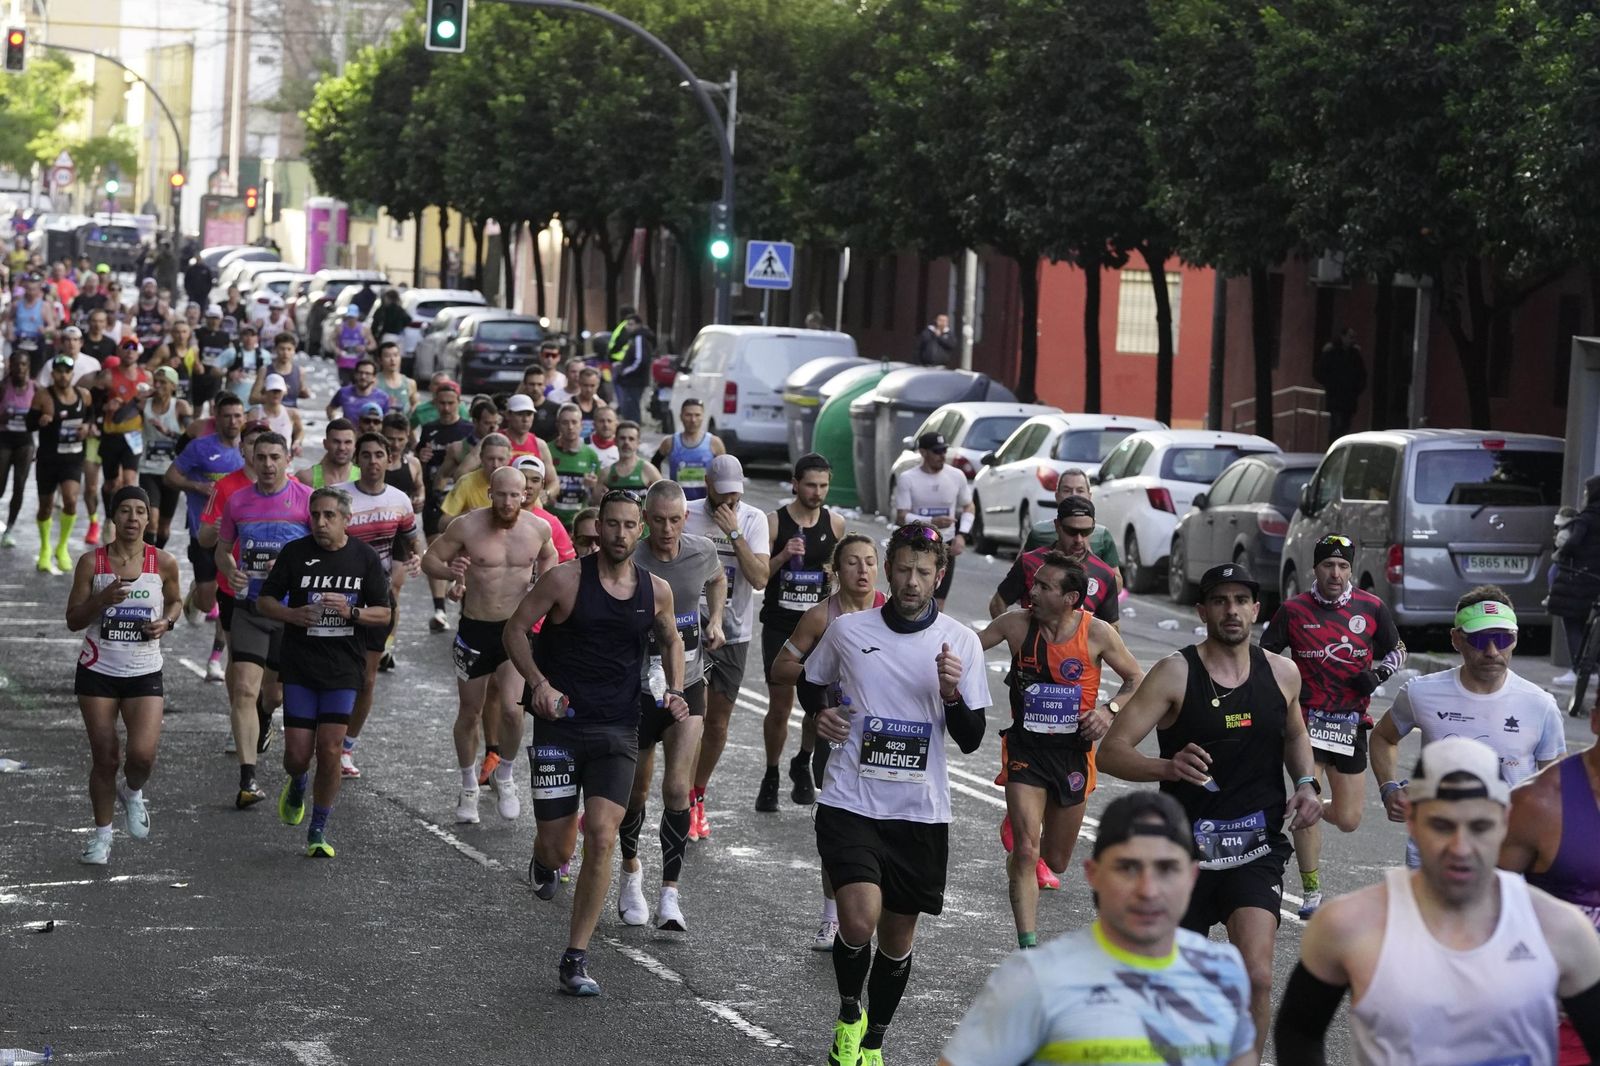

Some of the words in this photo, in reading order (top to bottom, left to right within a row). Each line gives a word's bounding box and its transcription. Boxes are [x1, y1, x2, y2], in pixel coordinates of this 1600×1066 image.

[1471, 557, 1500, 568] 5865
[1503, 558, 1526, 568] KNT
[794, 573, 819, 581] ZURICH
[127, 590, 150, 599] ICO
[782, 591, 819, 602] RICARDO
[108, 630, 142, 641] ERICKA
[1043, 686, 1075, 694] ZURICH
[1024, 712, 1058, 723] ANTONIO
[1225, 713, 1251, 721] BERLIN
[887, 722, 923, 734] ZURICH
[1226, 720, 1241, 728] RUN
[1310, 728, 1353, 745] CADENAS
[885, 740, 906, 751] 4829
[537, 749, 568, 757] ZURICH
[867, 750, 920, 768] JIMÉNEZ
[1219, 816, 1257, 831] ZURICH
[1221, 836, 1243, 847] 4714
